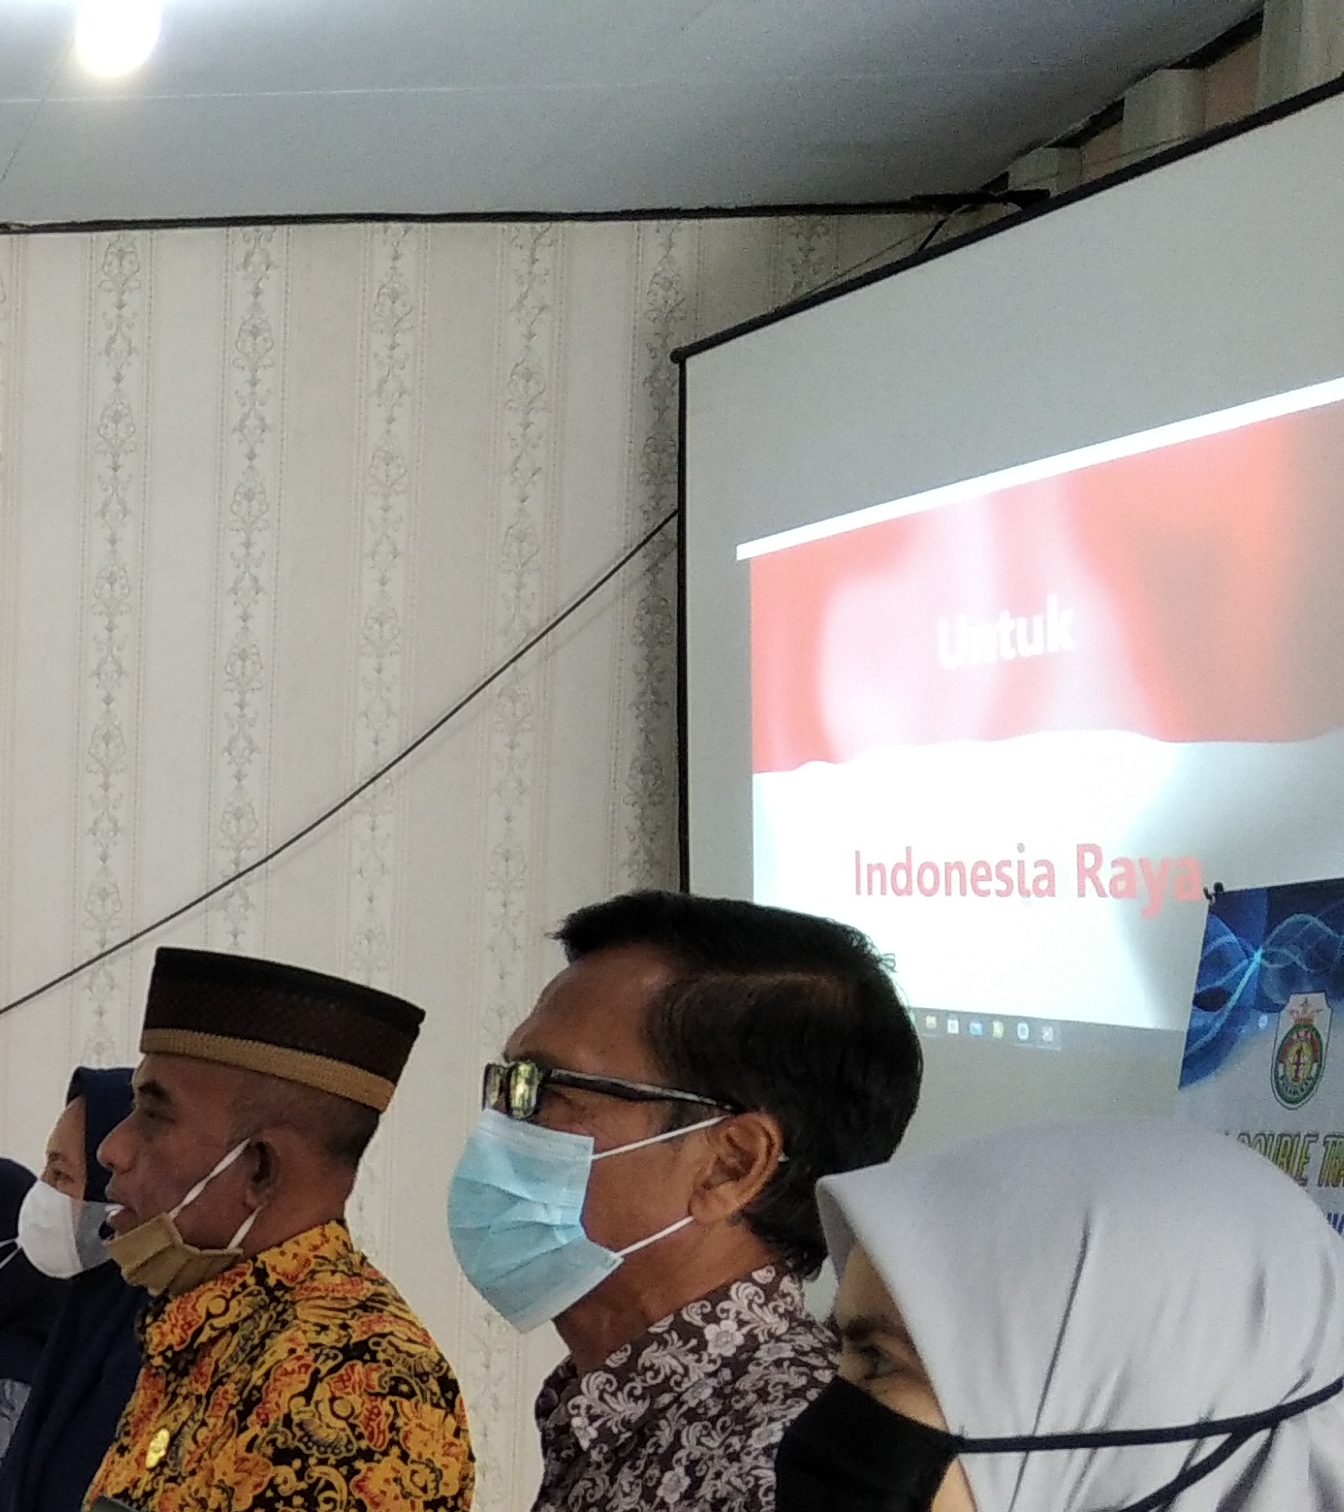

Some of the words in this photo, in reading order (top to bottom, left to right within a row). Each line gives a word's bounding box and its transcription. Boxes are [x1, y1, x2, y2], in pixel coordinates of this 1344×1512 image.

[936, 592, 1078, 670] Untuk
[854, 842, 1057, 899] Indonesia
[1075, 842, 1204, 920] Raya
